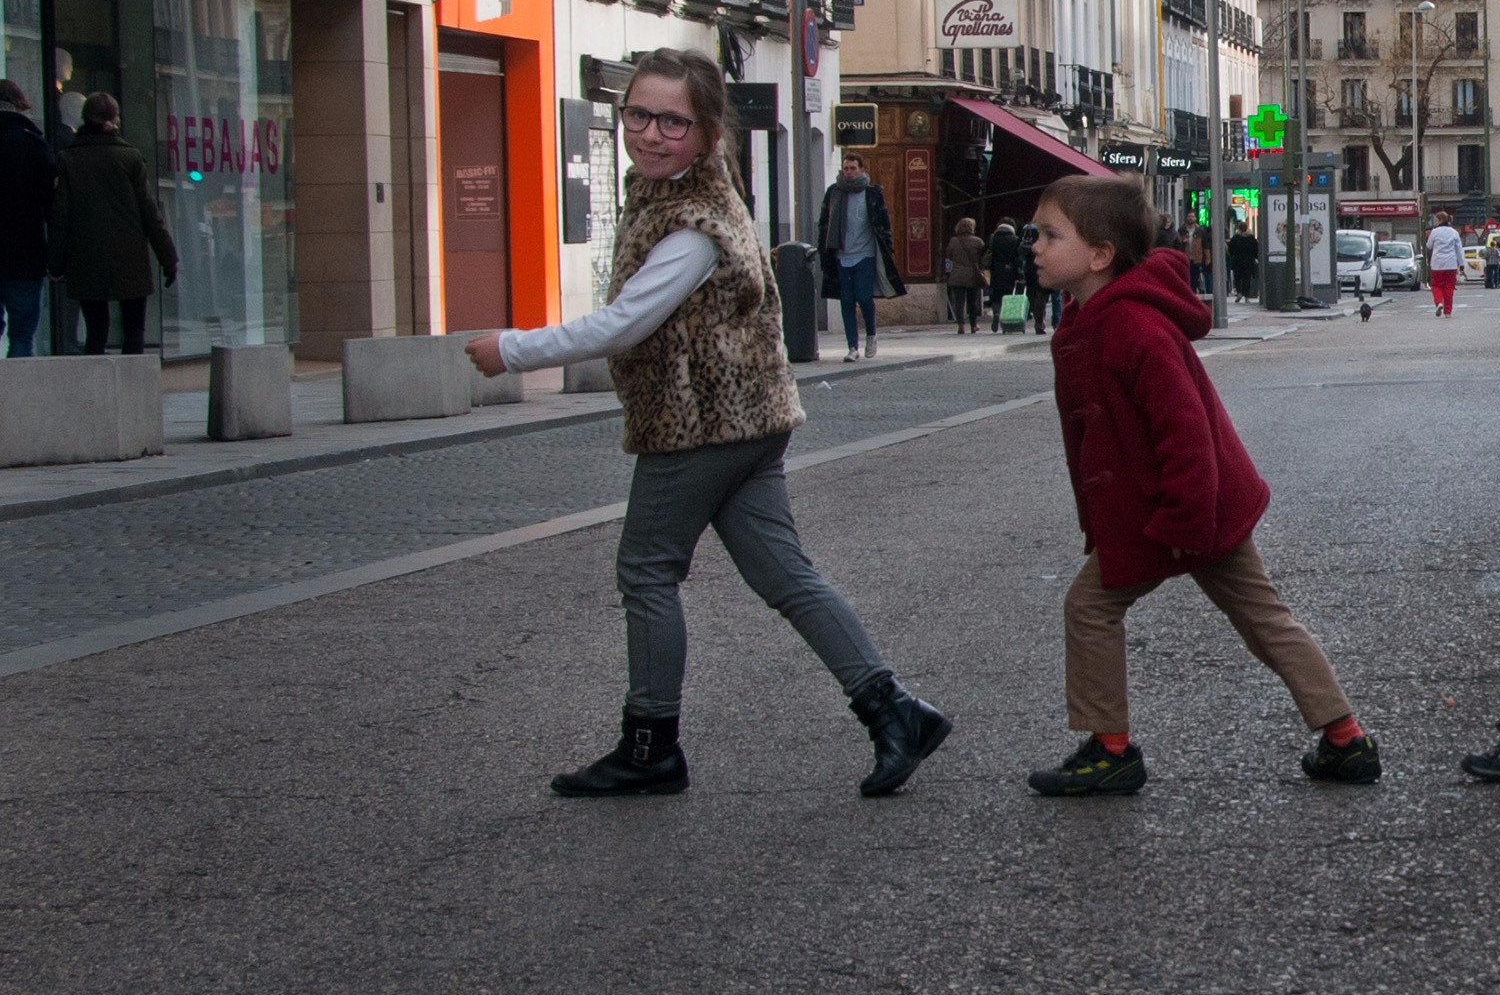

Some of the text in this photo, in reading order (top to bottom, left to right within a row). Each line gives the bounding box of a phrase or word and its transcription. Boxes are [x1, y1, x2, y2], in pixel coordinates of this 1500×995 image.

[838, 121, 874, 130] OYSHO
[167, 115, 279, 174] REBAJAS
[1109, 152, 1137, 165] Sfera
[1161, 157, 1186, 168] Sfera
